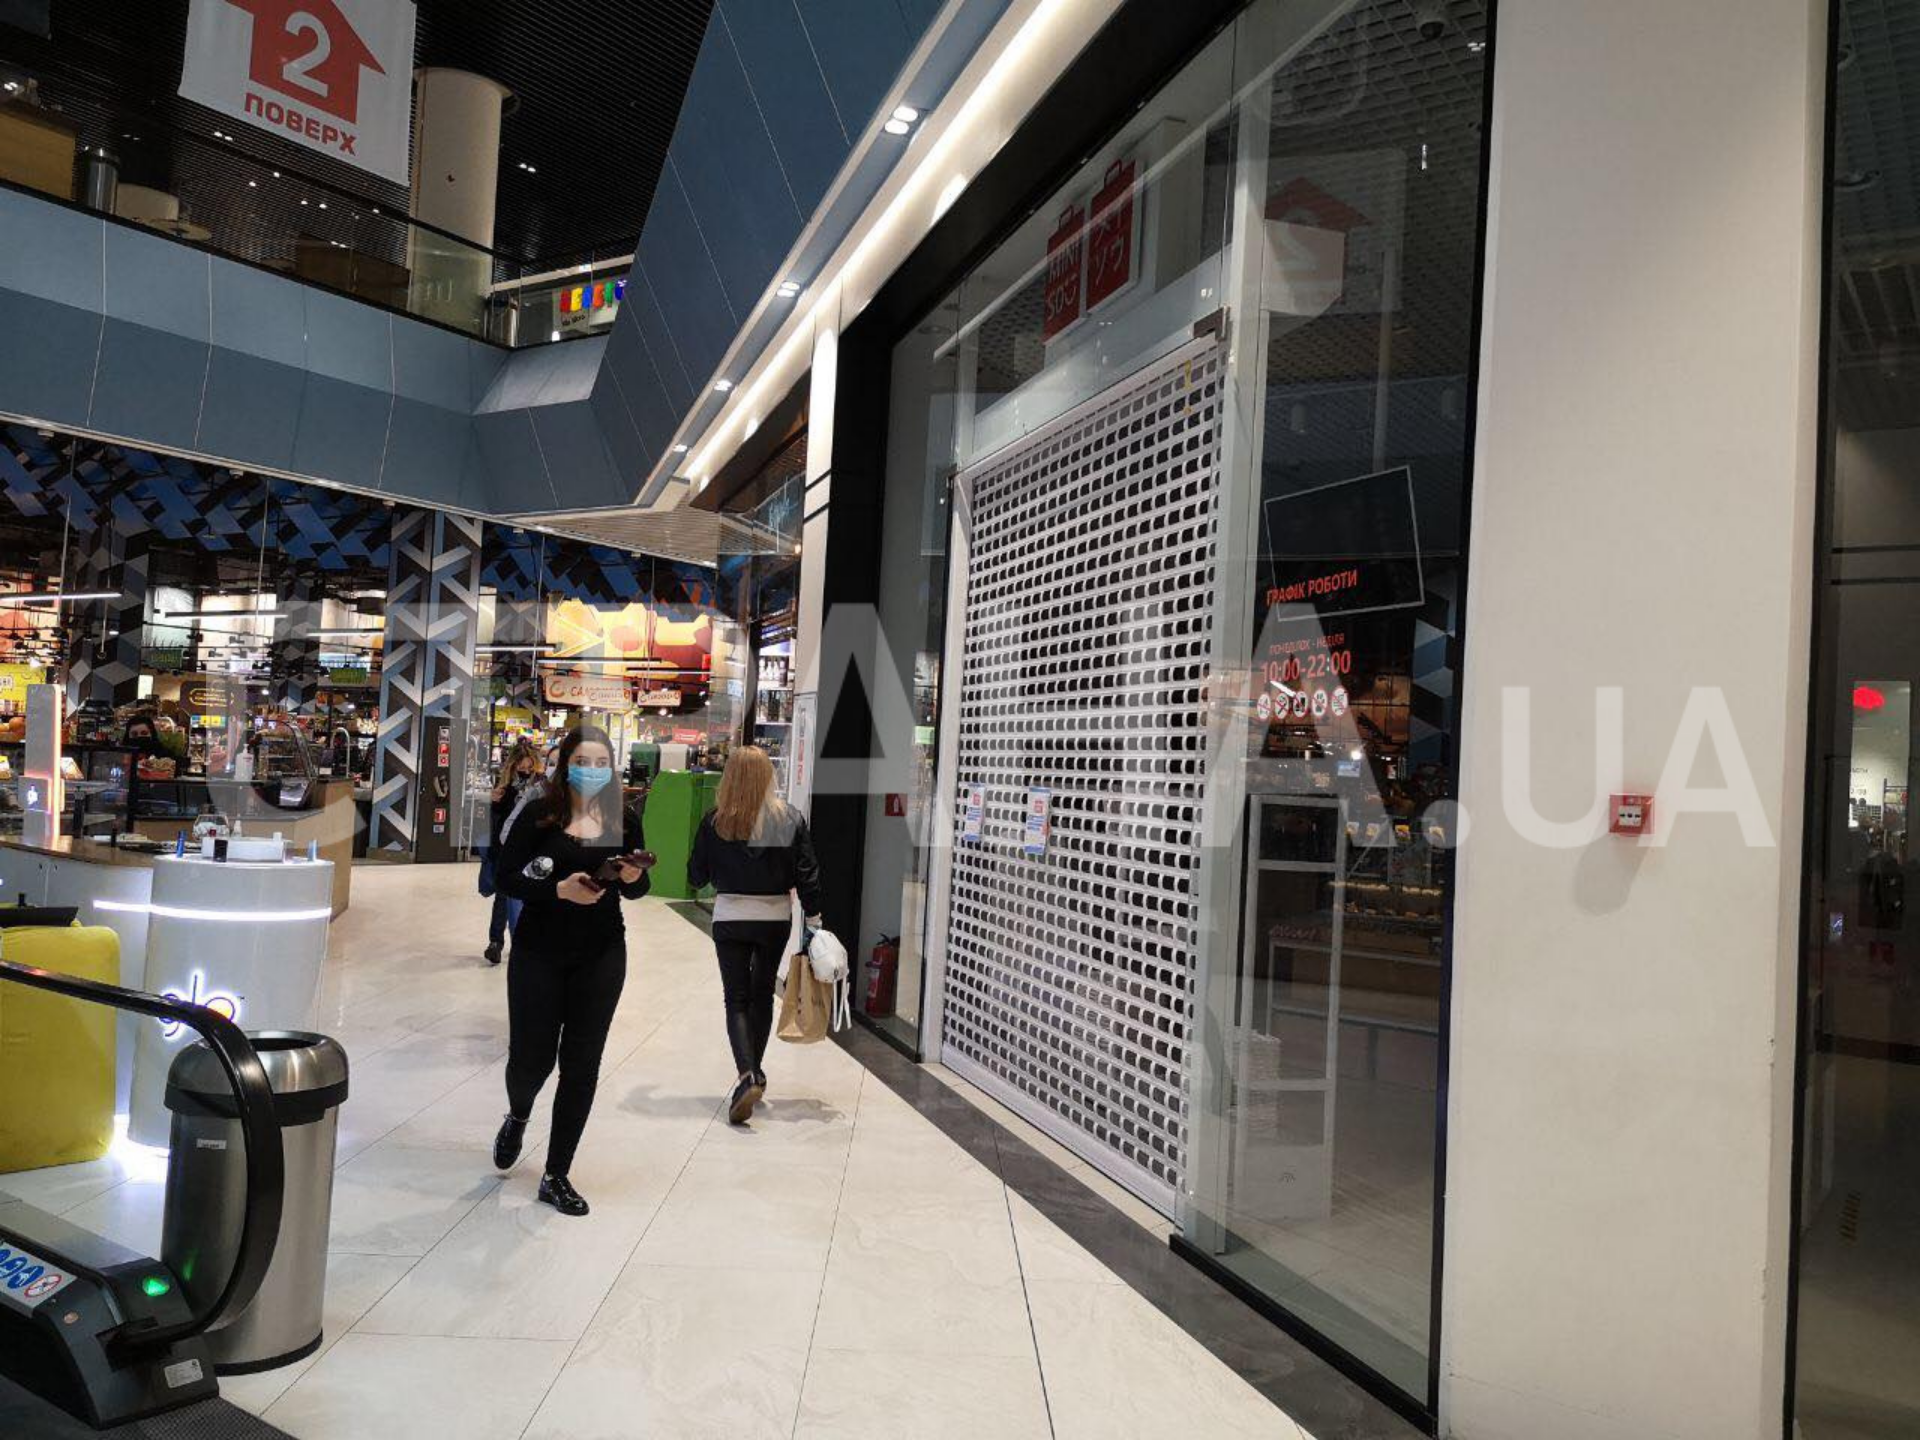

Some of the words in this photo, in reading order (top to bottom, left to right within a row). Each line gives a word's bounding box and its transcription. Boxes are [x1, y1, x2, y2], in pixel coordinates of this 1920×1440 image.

[282, 11, 331, 98] 2
[244, 92, 357, 157] ПОВЕРХ
[1266, 582, 1306, 607] ГРАФІК
[1308, 569, 1357, 597] РОБОТИ
[1260, 650, 1352, 683] 10:00-22:00
